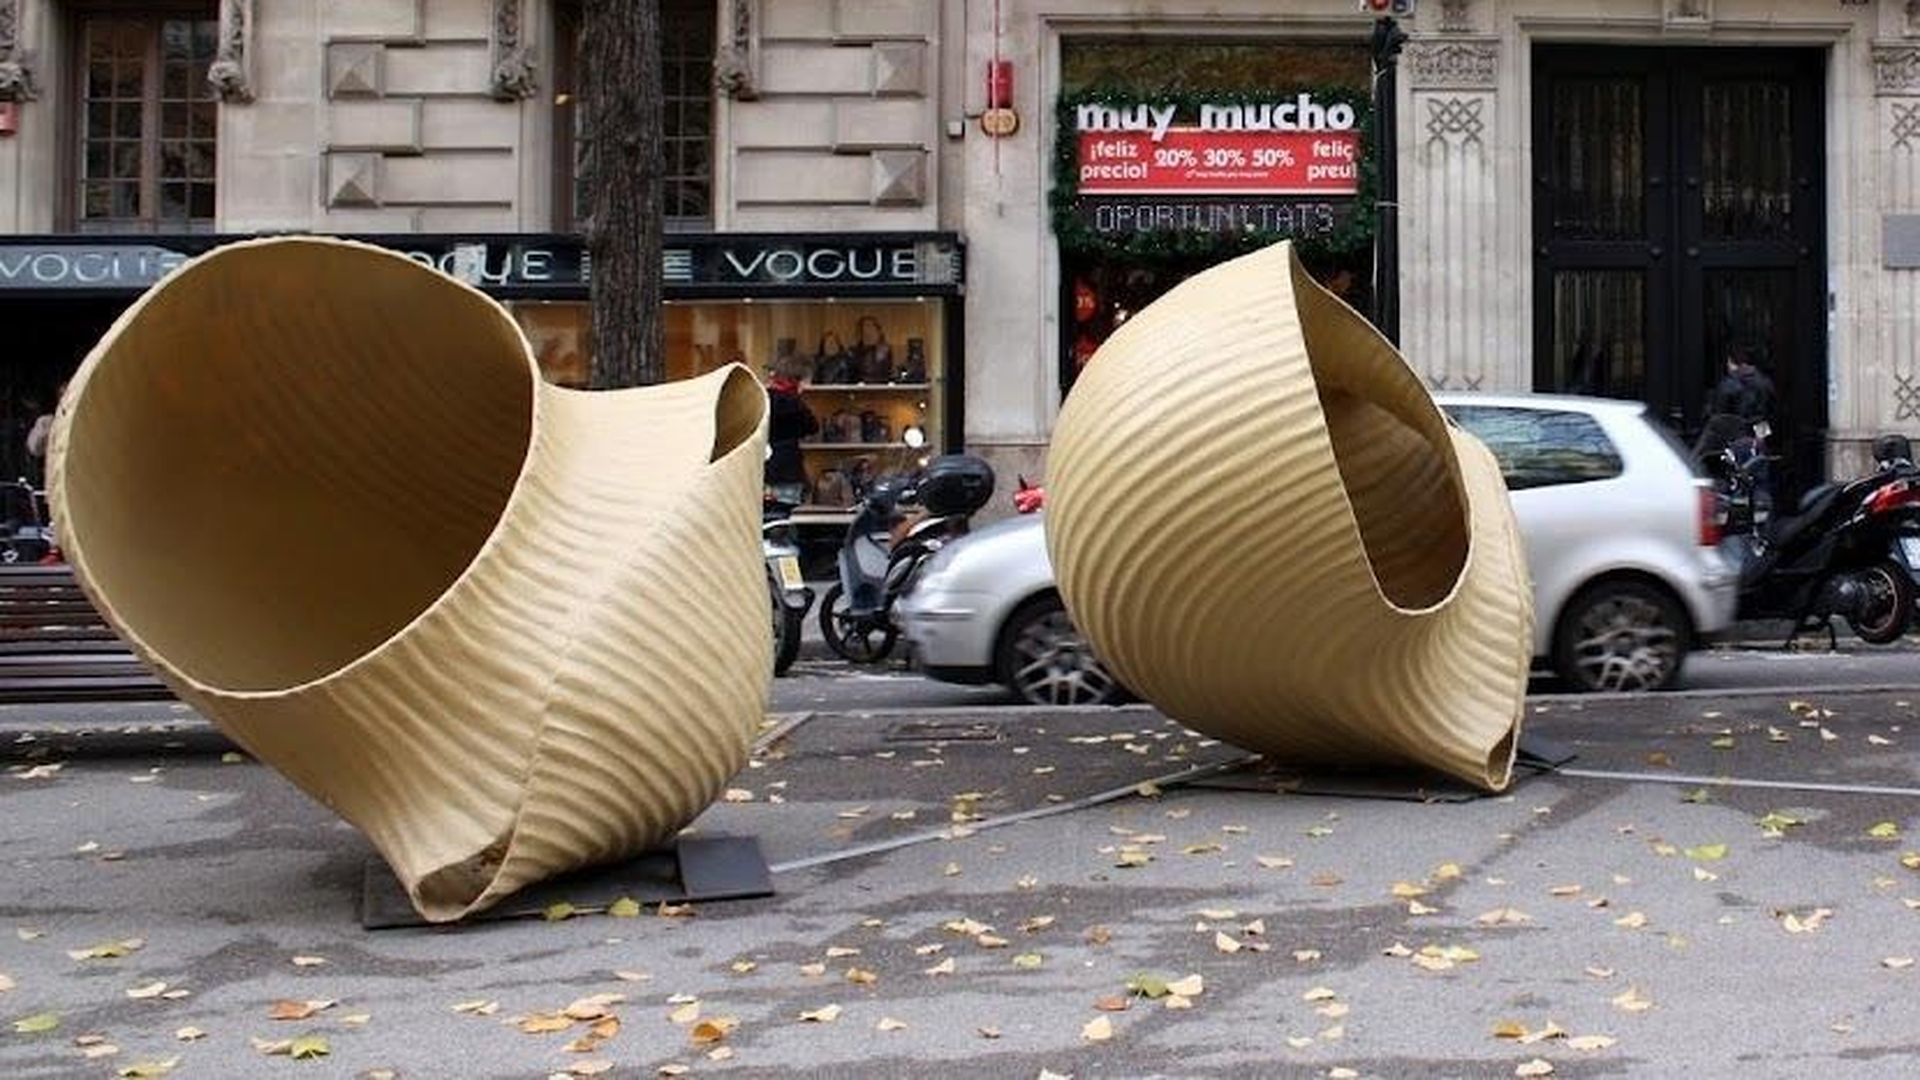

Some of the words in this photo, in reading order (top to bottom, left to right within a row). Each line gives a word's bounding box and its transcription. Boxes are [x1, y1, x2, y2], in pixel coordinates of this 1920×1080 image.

[1077, 103, 1178, 142] muy
[1200, 93, 1355, 132] mucho
[1090, 140, 1139, 161] ¡feliz
[1154, 148, 1198, 168] 20%
[1203, 148, 1246, 168] 30%
[1251, 148, 1295, 168] 50%
[1080, 161, 1148, 183] precio!
[1095, 203, 1334, 233] OPORTUNITATS
[725, 249, 918, 280] VOGUE
